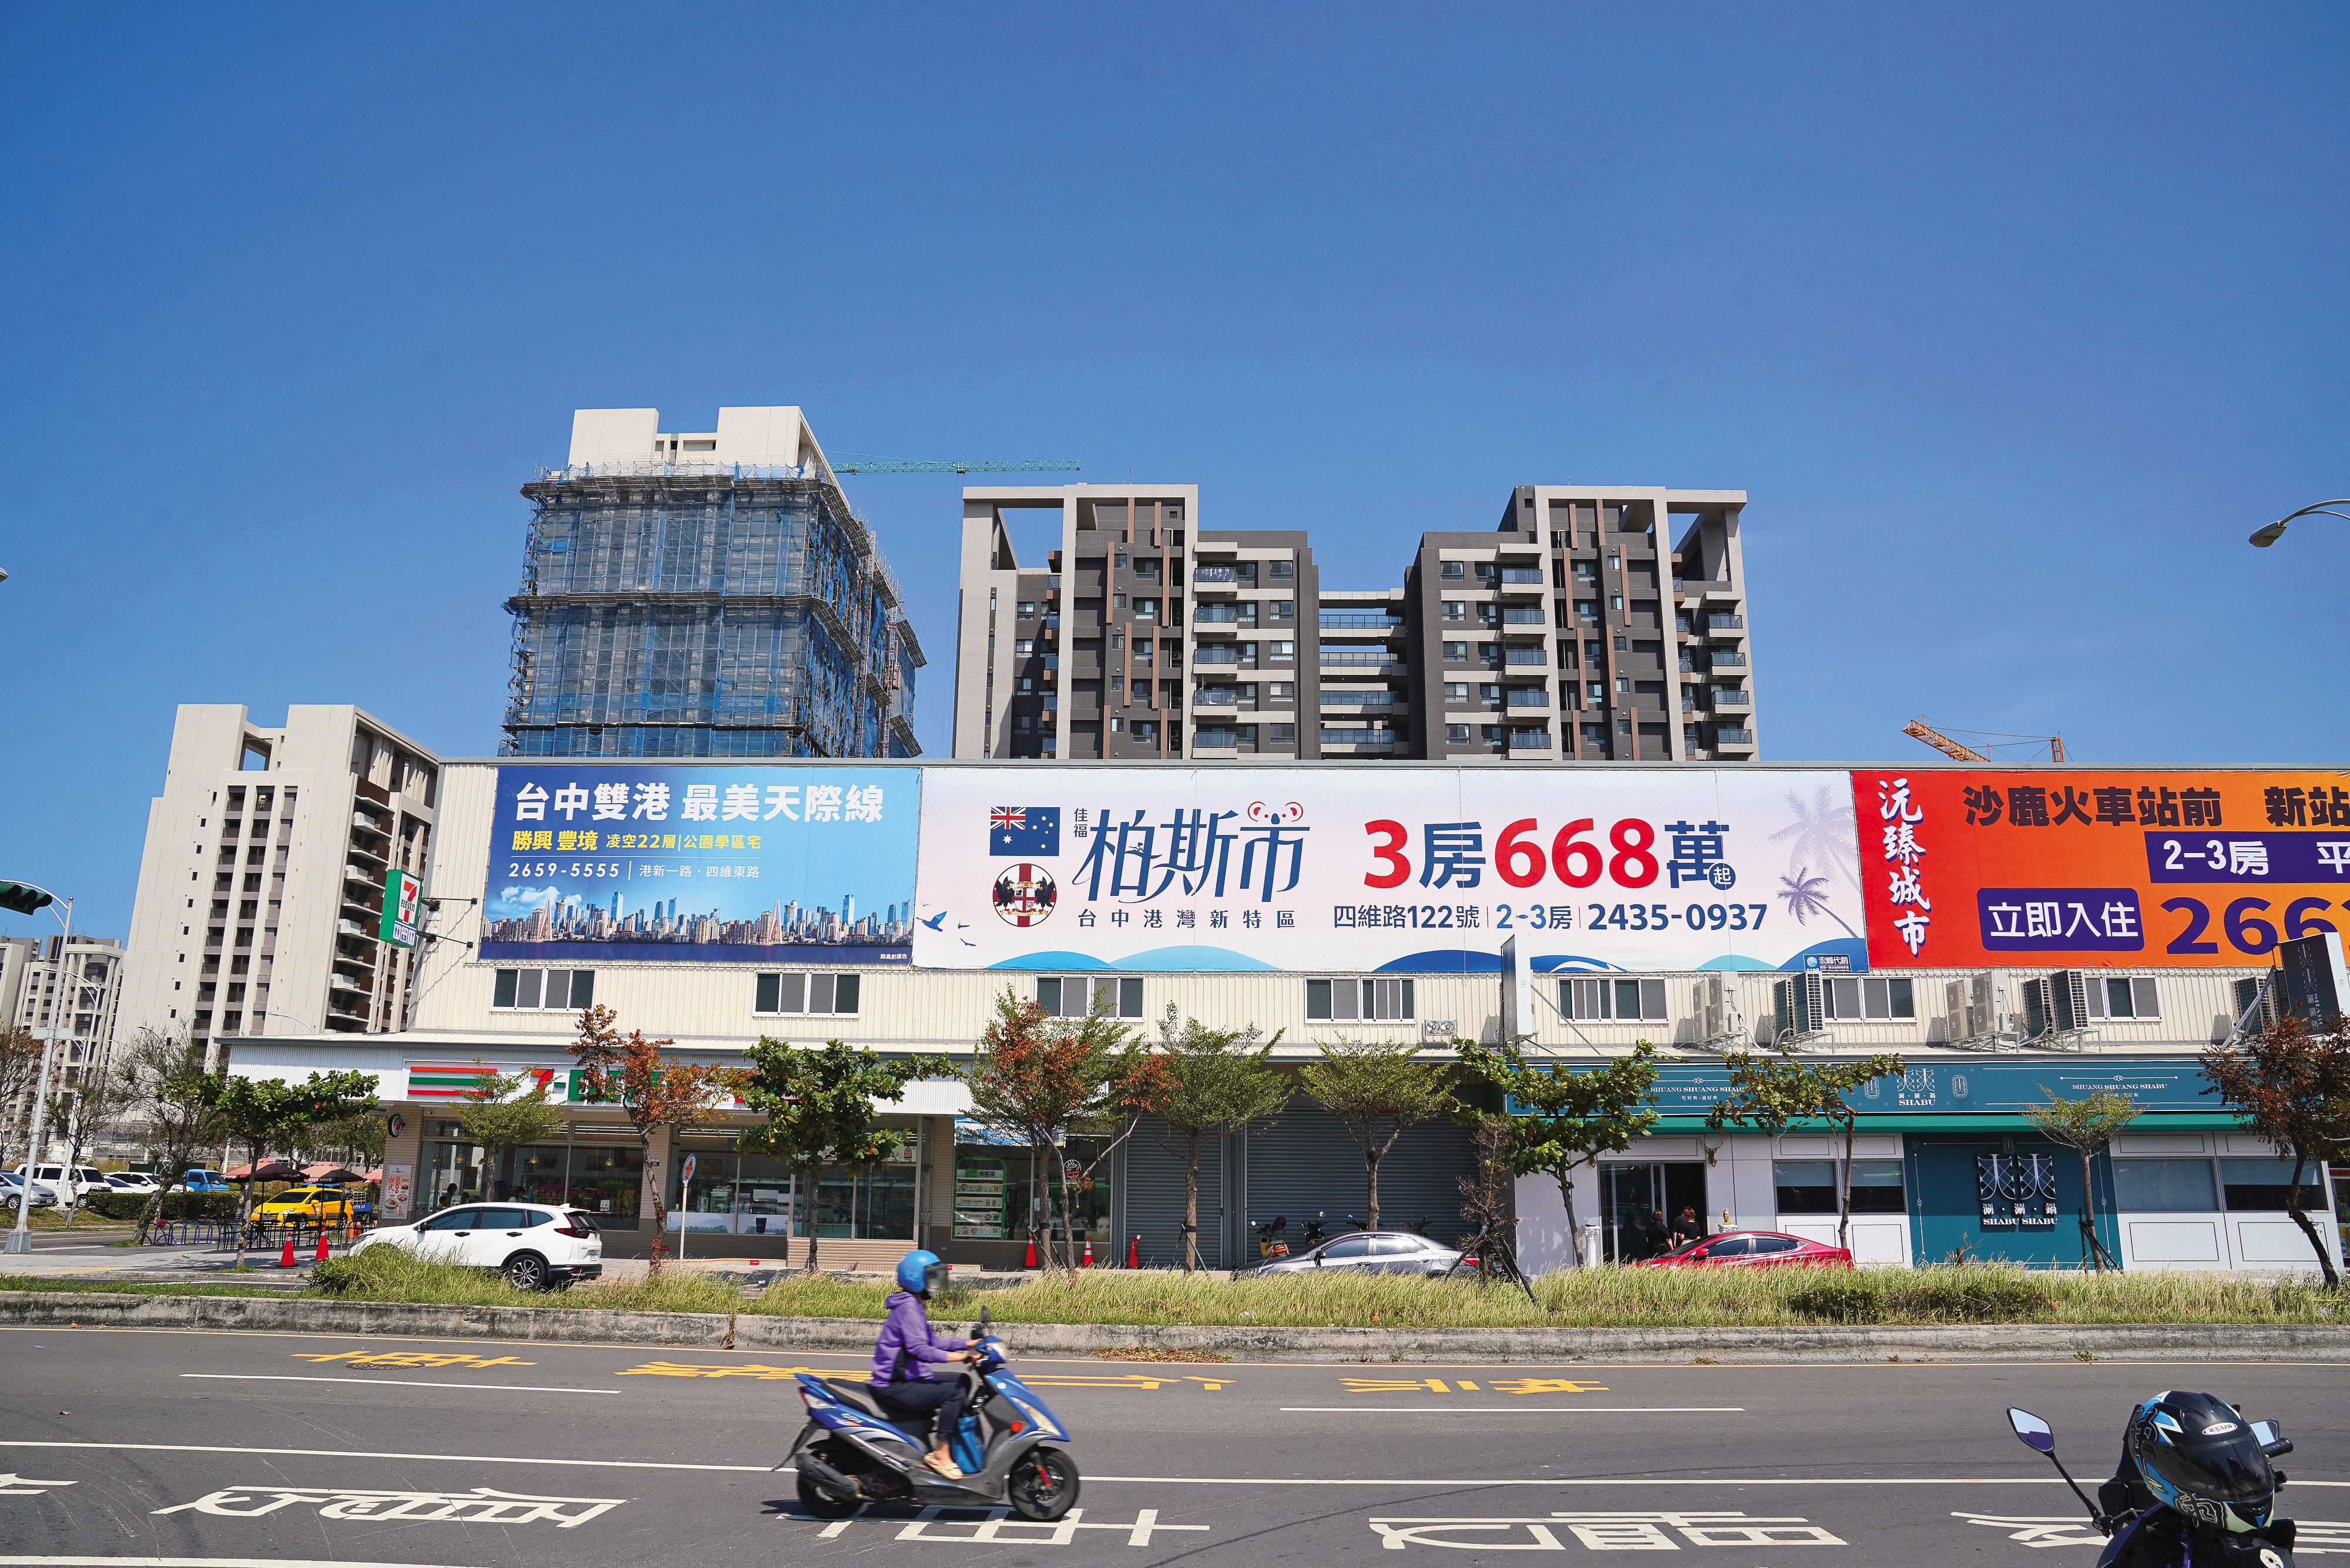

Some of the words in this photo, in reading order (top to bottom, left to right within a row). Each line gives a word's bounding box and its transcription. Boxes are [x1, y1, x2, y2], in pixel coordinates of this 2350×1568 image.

[516, 782, 670, 821] 台中雙港
[682, 784, 884, 822] 最美天際線
[1963, 786, 2222, 827] 沙鹿火車站前
[2264, 787, 2350, 827] 新站
[1073, 808, 1088, 838] 佳福
[512, 831, 552, 851] 勝興
[556, 831, 598, 851] 豐境
[1072, 808, 1310, 904] 柏斯市
[509, 862, 620, 878] 2659-5555
[2317, 842, 2350, 874] 平
[1077, 909, 1295, 928] 台中港灣新特區
[1334, 905, 1479, 929] 四維路122號
[1587, 904, 1767, 931] 2435-0937
[1989, 901, 2139, 938] 立即入住
[2160, 896, 2350, 955] 266
[2208, 1424, 2232, 1432] ZEUS
